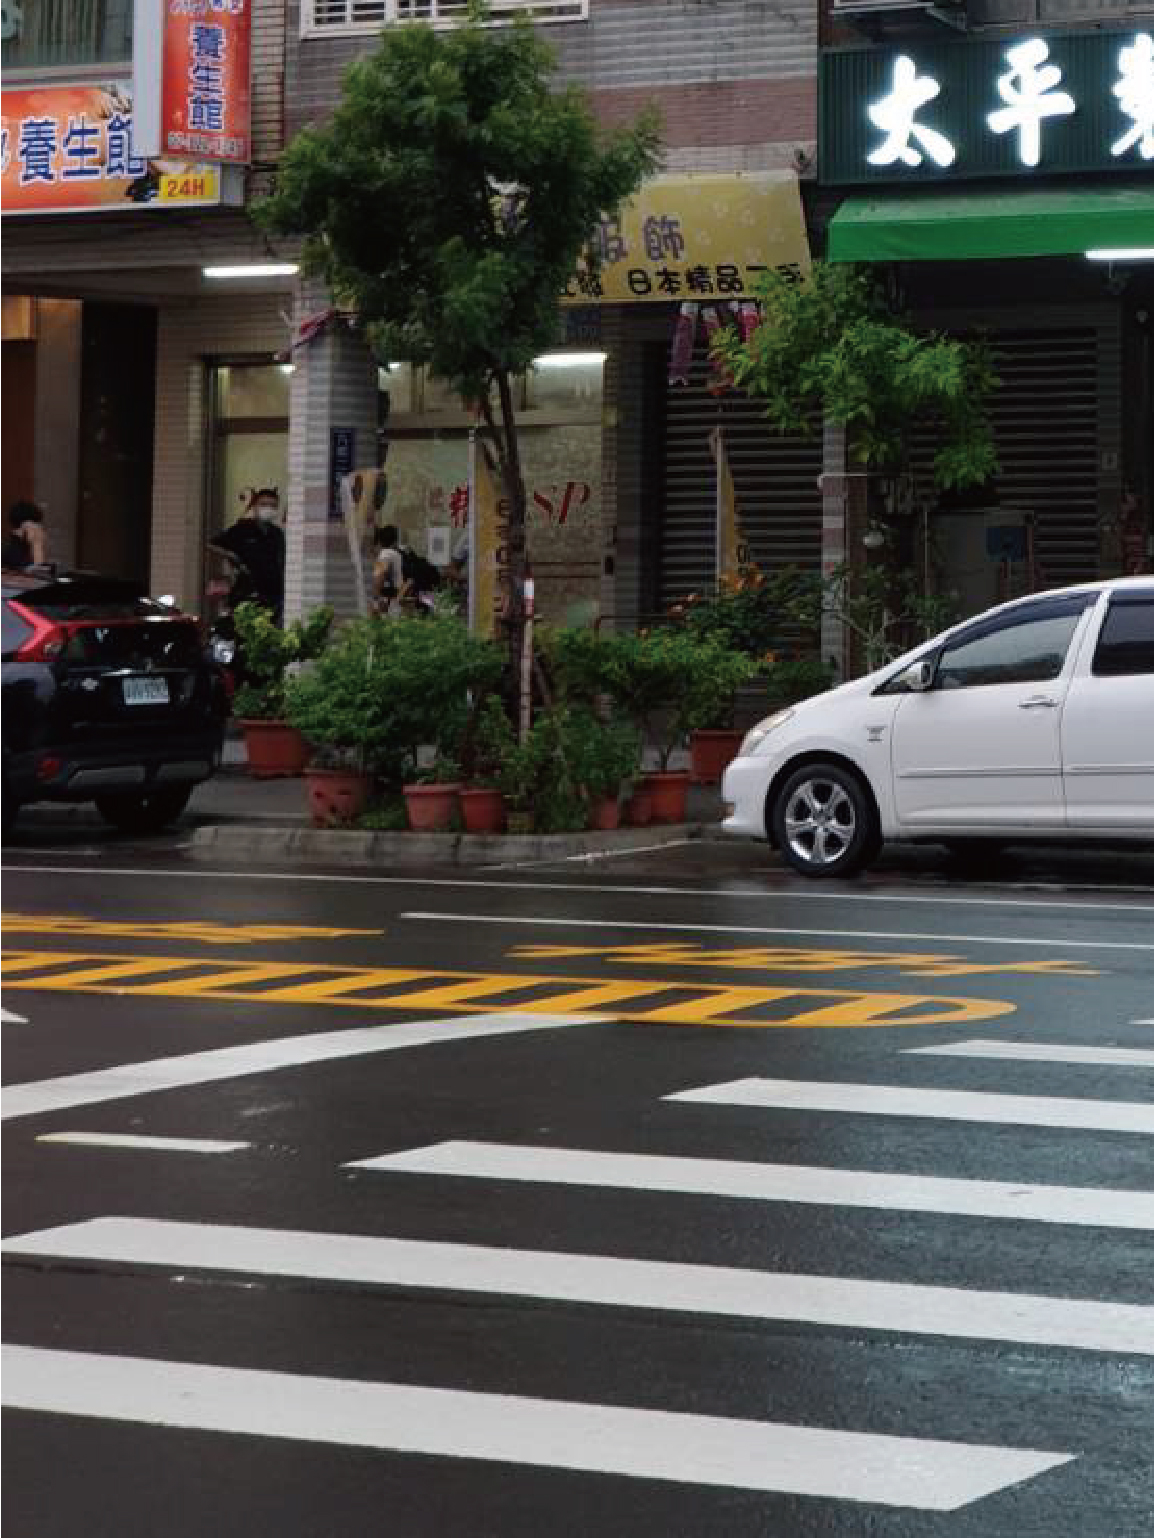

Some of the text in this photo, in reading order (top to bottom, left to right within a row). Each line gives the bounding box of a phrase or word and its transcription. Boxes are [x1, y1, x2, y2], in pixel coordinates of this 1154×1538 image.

[0, 112, 148, 186] 養生館
[166, 177, 206, 198] 24H
